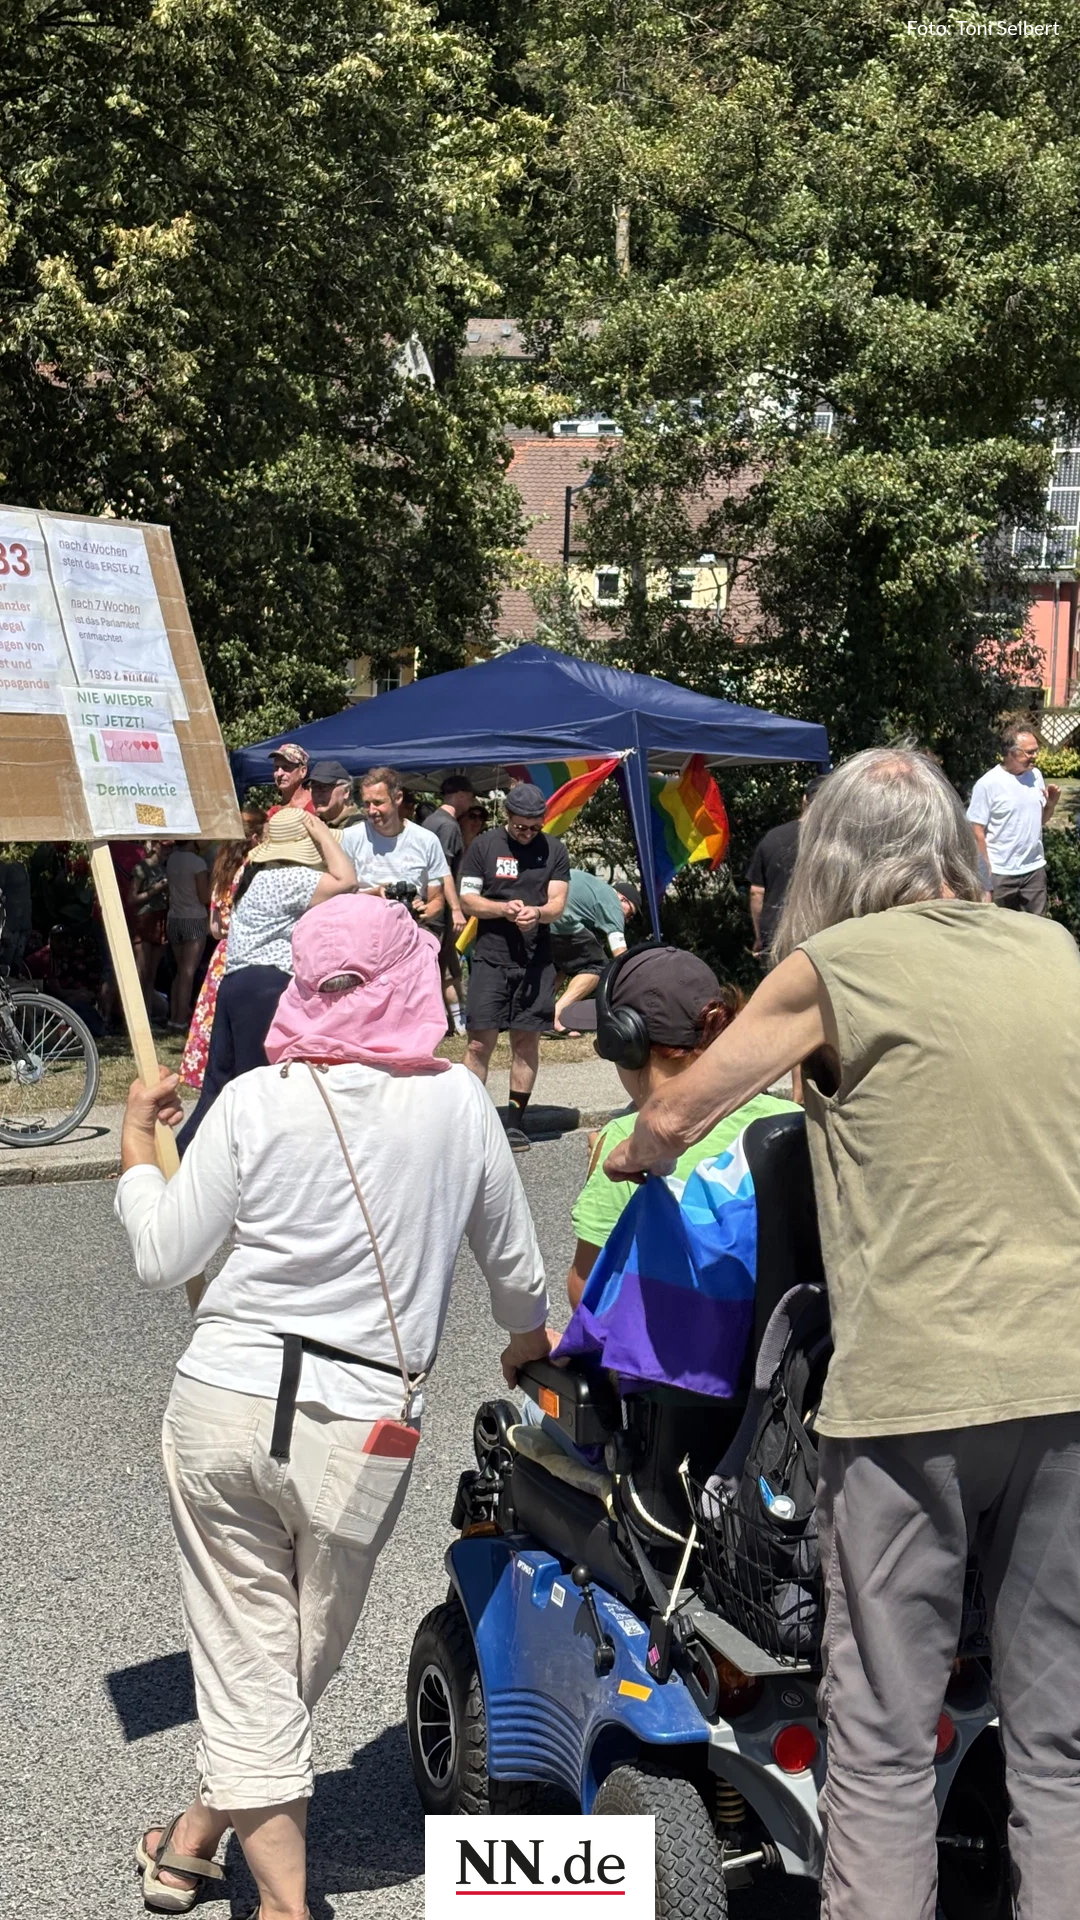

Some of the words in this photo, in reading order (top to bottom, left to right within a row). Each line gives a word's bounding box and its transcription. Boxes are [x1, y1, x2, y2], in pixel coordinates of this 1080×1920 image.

[59, 540, 81, 552] nach
[83, 543, 88, 552] 4
[89, 543, 128, 558] Wochen
[63, 557, 83, 568] steht
[84, 560, 100, 571] das
[101, 561, 128, 574] ERSTE
[129, 564, 140, 575] KZ
[71, 598, 93, 610] nach
[95, 600, 101, 610] 7
[102, 600, 141, 615] Wochen
[85, 616, 100, 626] das
[79, 631, 123, 642] entmachtet
[24, 642, 45, 652] von
[11, 659, 32, 670] und
[89, 669, 112, 680] 1939
[77, 691, 100, 704] NIE
[104, 693, 154, 707] WIEDER
[82, 713, 100, 726] IST
[105, 715, 145, 728] JETZT!
[96, 782, 177, 796] Demokratie
[496, 859, 518, 868] FCK
